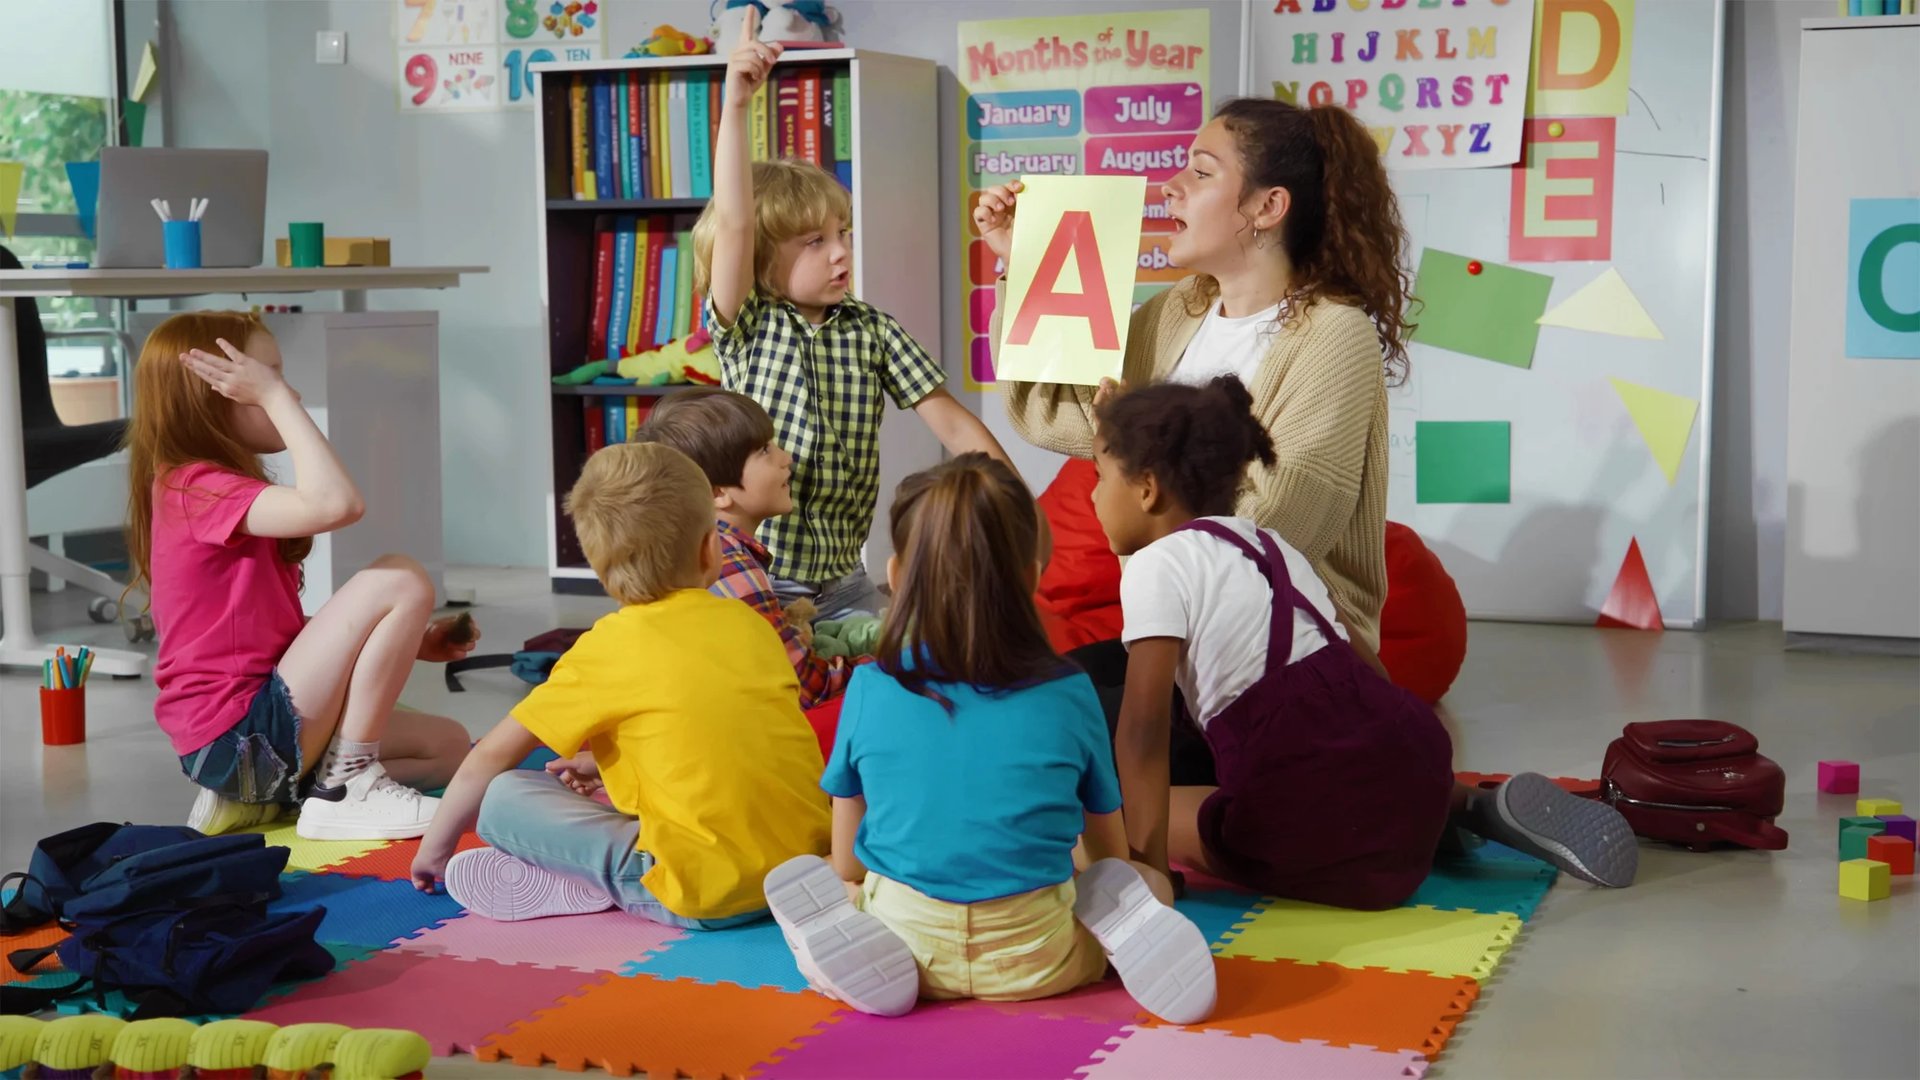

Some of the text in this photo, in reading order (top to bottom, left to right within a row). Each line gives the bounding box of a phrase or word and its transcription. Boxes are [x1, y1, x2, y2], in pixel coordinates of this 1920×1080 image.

[404, 0, 435, 42] 7
[505, 0, 539, 39] 8
[565, 49, 591, 61] TEN
[967, 27, 1204, 82] Months of the Year
[1292, 26, 1497, 64] H I J K L M
[1539, 0, 1621, 90] D
[405, 52, 484, 106] 9 NINE
[1272, 73, 1509, 112] N O P Q R S T
[804, 80, 814, 120] WORLD
[824, 90, 832, 127] LAW
[977, 103, 1072, 127] January
[1114, 95, 1172, 125] July
[693, 121, 704, 178] SURGERY
[1100, 145, 1189, 172] August
[1402, 125, 1430, 156] X
[1437, 124, 1463, 156] Y
[1469, 122, 1492, 153] Z
[630, 137, 640, 194] POLITICS
[974, 151, 1077, 176] February
[1524, 140, 1599, 237] E
[611, 232, 629, 350] Theory of Relativity
[1005, 211, 1121, 351] A
[644, 285, 656, 333] Analysis
